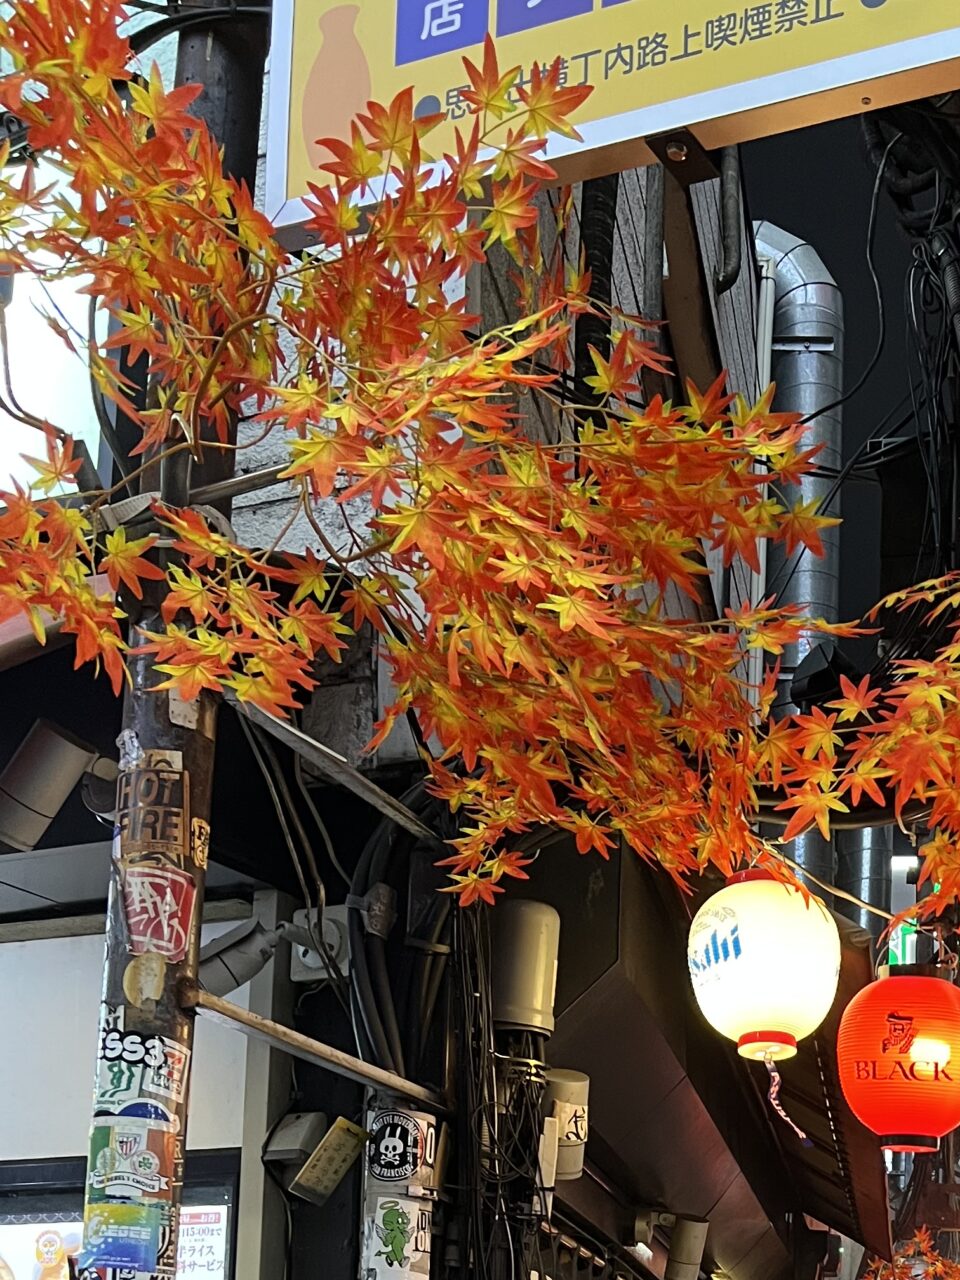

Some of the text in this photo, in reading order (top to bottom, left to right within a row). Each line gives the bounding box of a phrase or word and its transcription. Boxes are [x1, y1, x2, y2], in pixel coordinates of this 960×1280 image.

[117, 771, 176, 808] HOT
[117, 809, 182, 844] FIRE
[854, 1060, 953, 1081] BLACK
